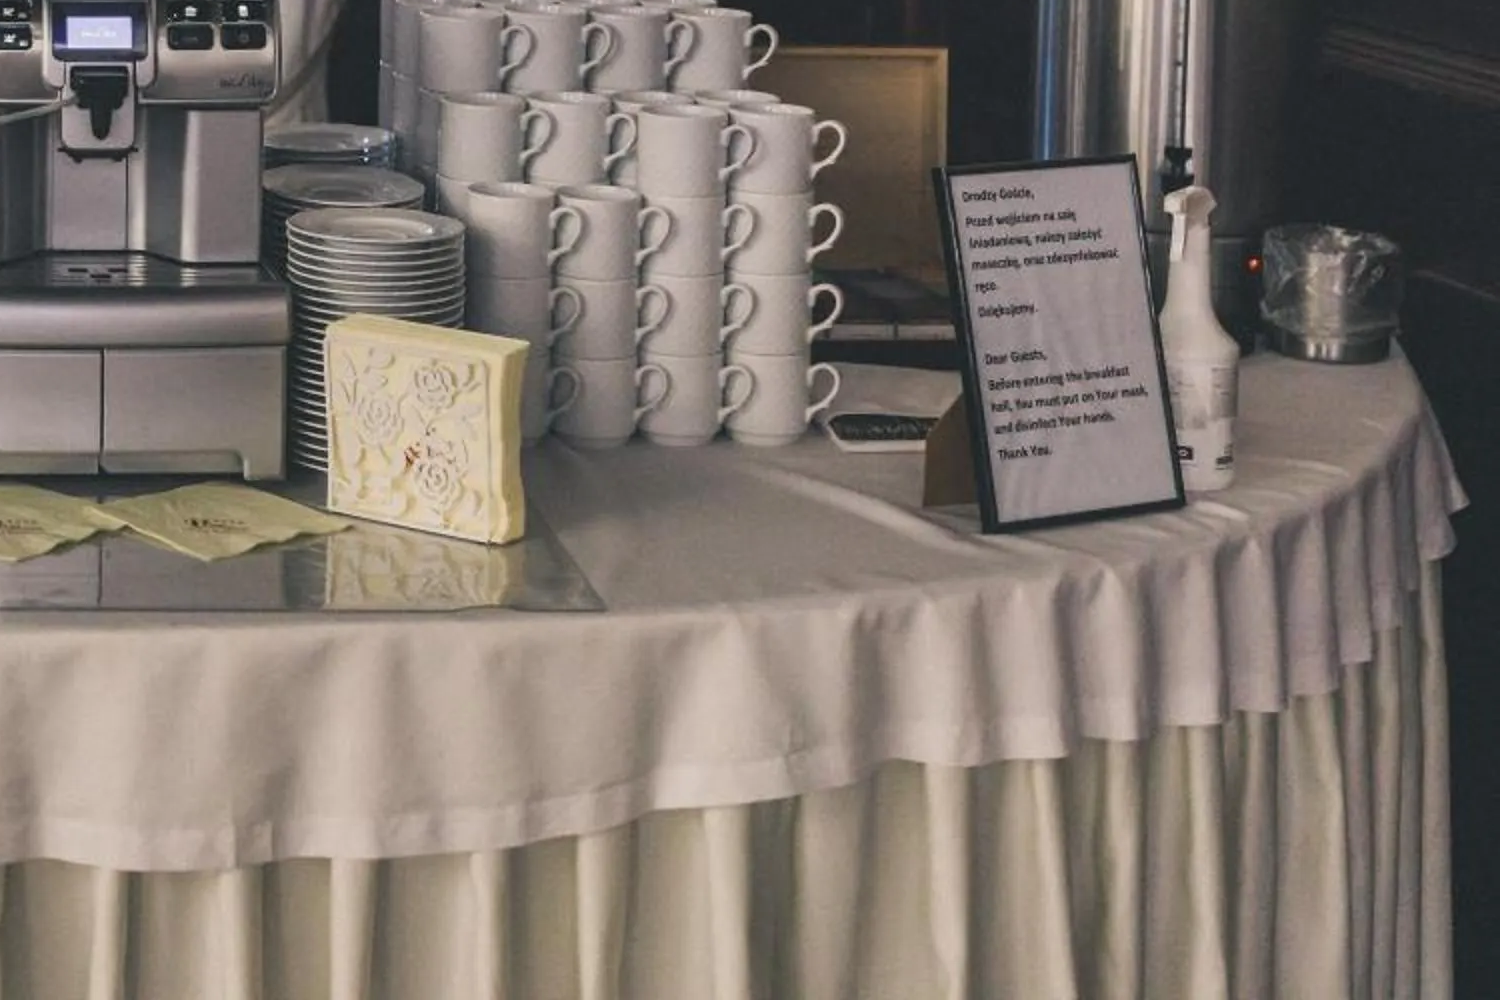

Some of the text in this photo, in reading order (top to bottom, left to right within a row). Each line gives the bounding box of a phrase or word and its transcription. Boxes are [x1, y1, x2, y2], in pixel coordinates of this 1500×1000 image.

[985, 350, 1047, 365] Dear Guests,
[988, 365, 1130, 391] Before entering the breakfast
[1035, 396, 1061, 407] must
[1061, 393, 1079, 405] put
[1081, 392, 1094, 402] on
[994, 422, 1013, 435] and
[998, 447, 1028, 460] Thank
